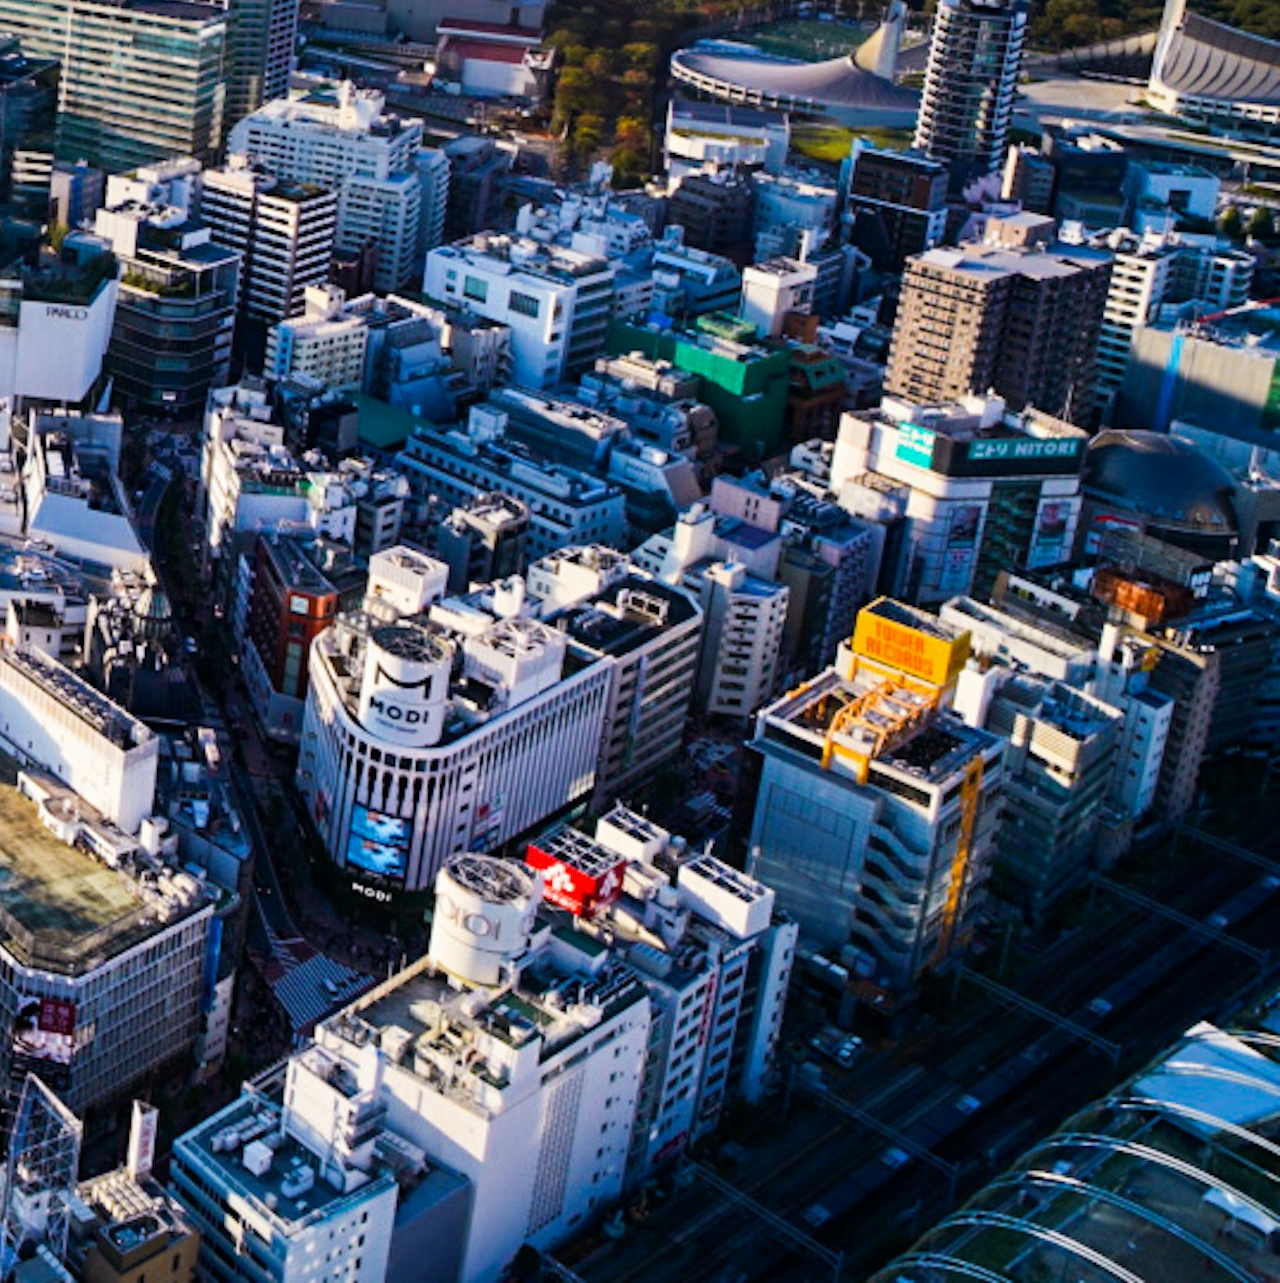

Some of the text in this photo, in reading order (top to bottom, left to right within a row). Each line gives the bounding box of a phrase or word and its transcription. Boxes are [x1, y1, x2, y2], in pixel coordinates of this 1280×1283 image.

[45, 305, 88, 322] PARCO
[974, 441, 1078, 458] ニトリ NITORI
[876, 620, 925, 655] TOWER
[867, 636, 933, 676] RECORDS
[370, 696, 430, 725] MODI
[351, 881, 393, 903] MODI
